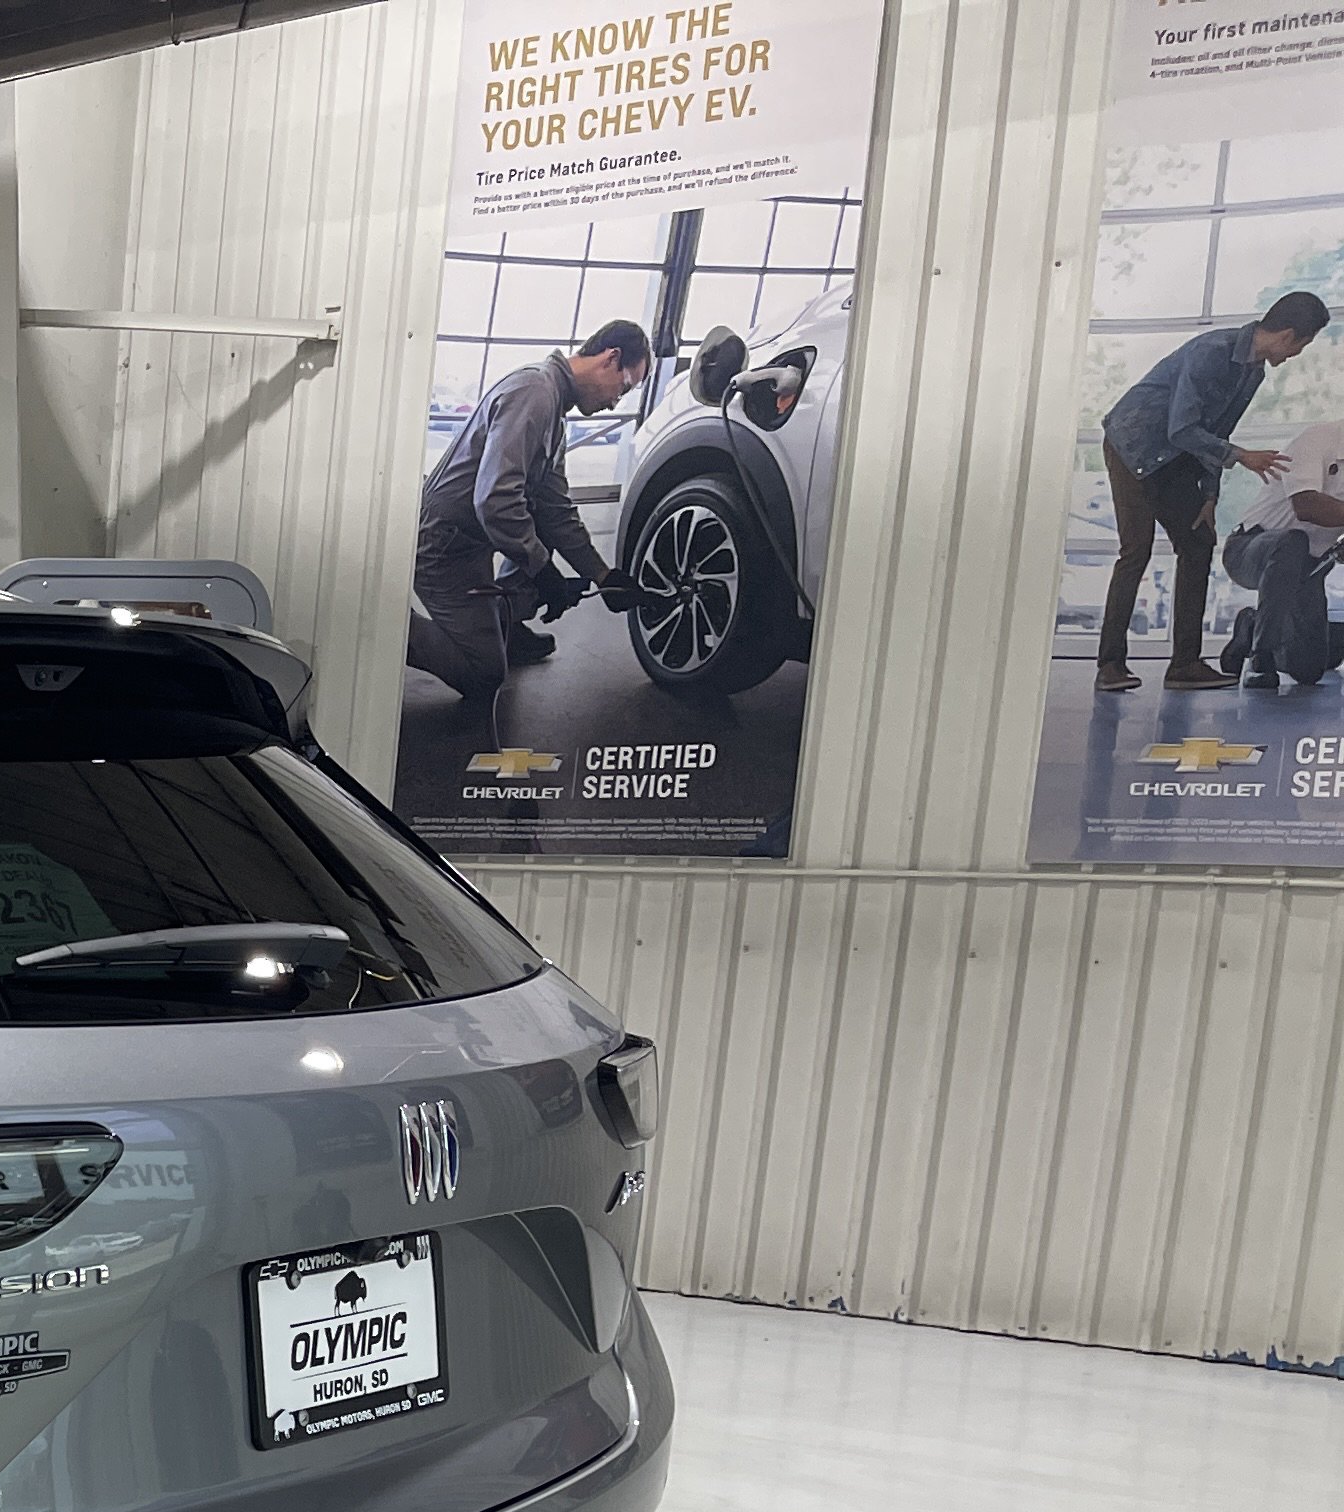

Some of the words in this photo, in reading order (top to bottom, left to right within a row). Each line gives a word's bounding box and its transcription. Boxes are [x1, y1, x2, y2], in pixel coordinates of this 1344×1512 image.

[489, 34, 540, 72] WE
[551, 16, 654, 63] KNOW
[665, 3, 733, 45] THE
[1155, 28, 1198, 45] Your
[1204, 21, 1246, 40] first
[484, 69, 584, 113] RIGHT
[594, 52, 690, 98] TIRES
[703, 39, 770, 81] FOR
[482, 112, 566, 154] YOUR
[577, 93, 696, 140] CHEVY
[705, 84, 757, 122] EV.
[476, 171, 503, 186] Tire
[508, 166, 545, 182] Price
[550, 158, 594, 178] Match
[599, 150, 682, 171] Guarantee.
[595, 181, 615, 192] price
[628, 177, 641, 185] the
[663, 172, 671, 181] of
[715, 164, 730, 173] and
[754, 157, 780, 167] match
[581, 194, 599, 204] days
[612, 190, 624, 199] the
[735, 173, 748, 182] the
[585, 743, 717, 771] CERTIFIED
[462, 786, 564, 800] CHEVROLET
[582, 773, 690, 799] SERVICE
[1129, 782, 1266, 798] CHEVROLET
[290, 1311, 408, 1371] OLYMPIC
[22, 1359, 43, 1372] GMC
[4, 1381, 18, 1394] SD
[313, 1374, 367, 1402] HURON,
[371, 1368, 389, 1388] SD
[417, 1388, 445, 1407] GMC
[306, 1418, 340, 1435] OLYMPIC
[340, 1409, 376, 1426] MOTORS,
[401, 1399, 412, 1411] SD
